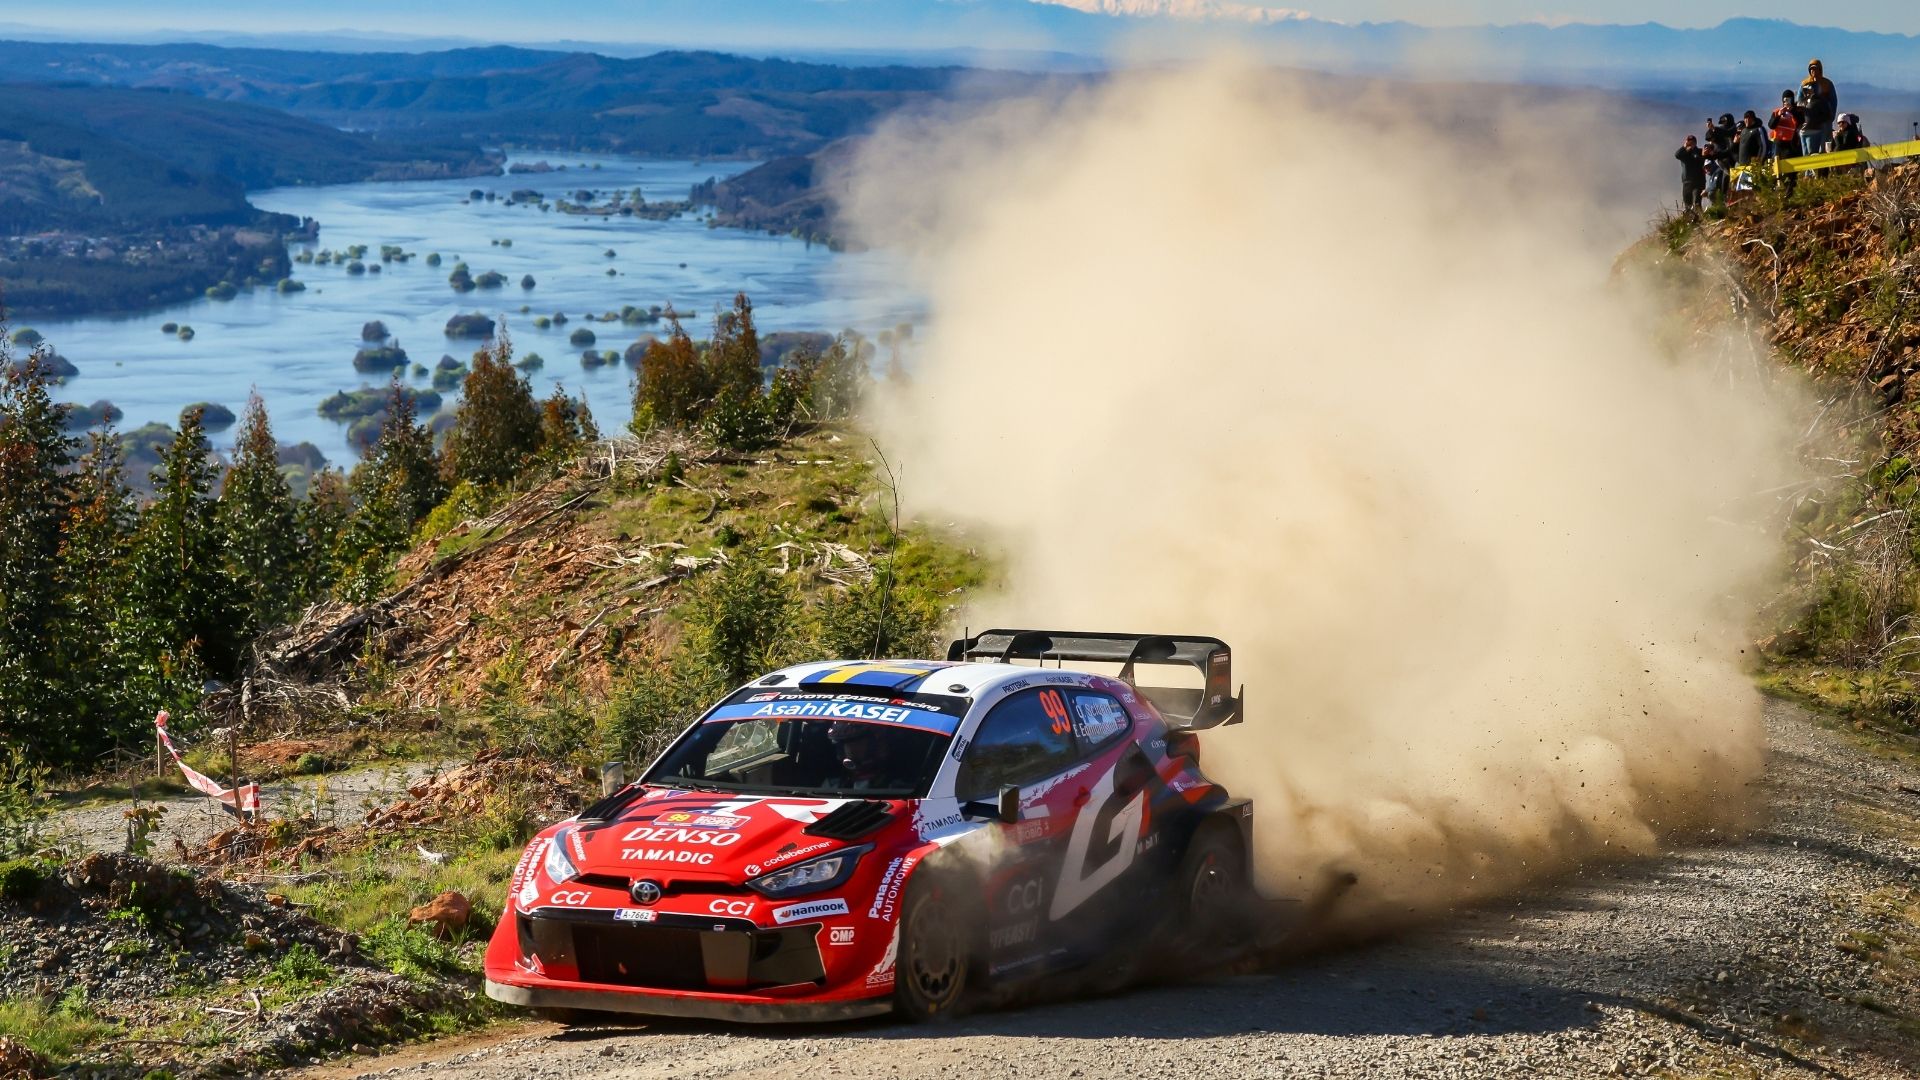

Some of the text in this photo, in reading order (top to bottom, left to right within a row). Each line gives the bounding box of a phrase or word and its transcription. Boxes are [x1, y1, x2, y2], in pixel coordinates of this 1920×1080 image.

[752, 703, 912, 723] AsahiKASEI
[1039, 689, 1072, 735] 99
[667, 813, 690, 822] 99
[925, 814, 961, 830] TAMADIC
[621, 827, 742, 847] DENSO
[620, 848, 714, 865] TAMADIC
[763, 840, 832, 867] codebeamer
[868, 857, 903, 919] Panasonic
[882, 857, 916, 922] AUTOMOTIVE
[622, 911, 649, 920] A-7662
[830, 929, 854, 942] OMP
